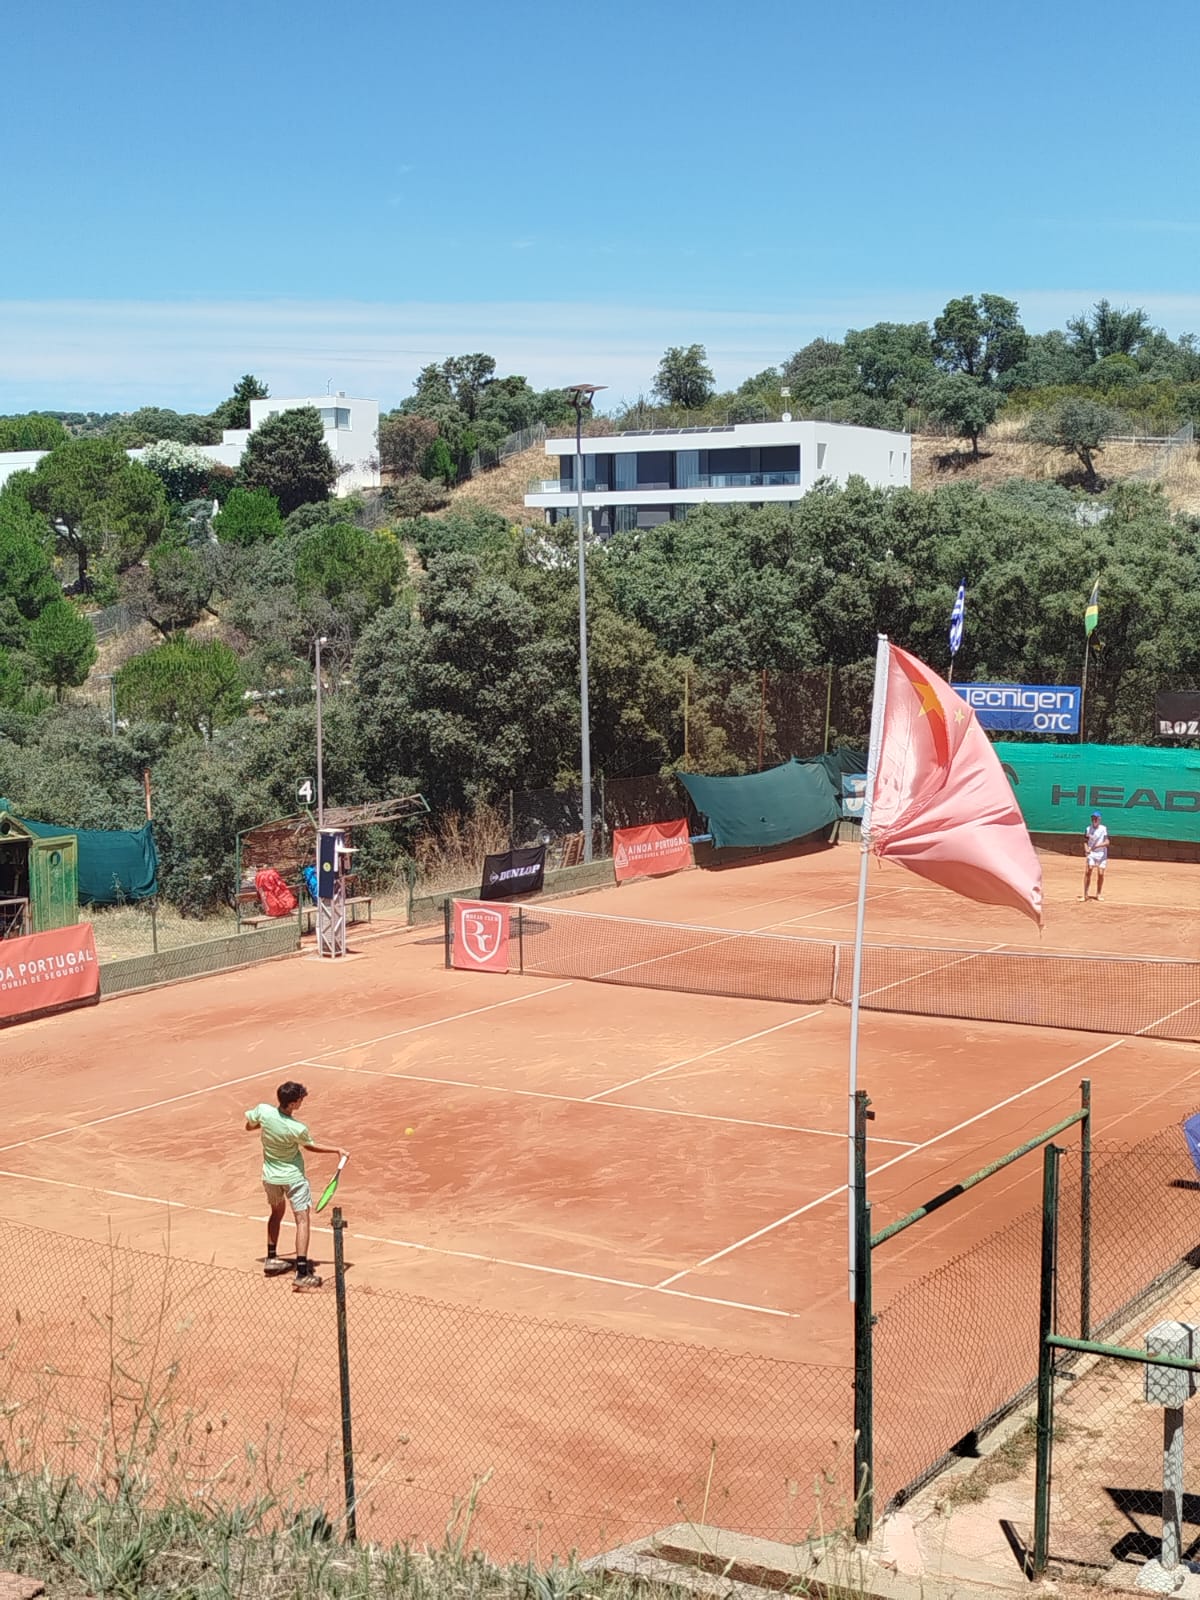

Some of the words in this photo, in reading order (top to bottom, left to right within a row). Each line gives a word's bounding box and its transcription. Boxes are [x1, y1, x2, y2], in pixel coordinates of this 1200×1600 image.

[1033, 713, 1071, 730] OTC
[298, 780, 312, 803] 4
[1051, 784, 1200, 813] HEAD
[655, 837, 687, 850] PORTUGAL
[498, 863, 540, 881] DUNLOP
[19, 949, 94, 976] PORTUGAL
[31, 975, 41, 984] DE
[45, 965, 85, 980] SEGUROS
